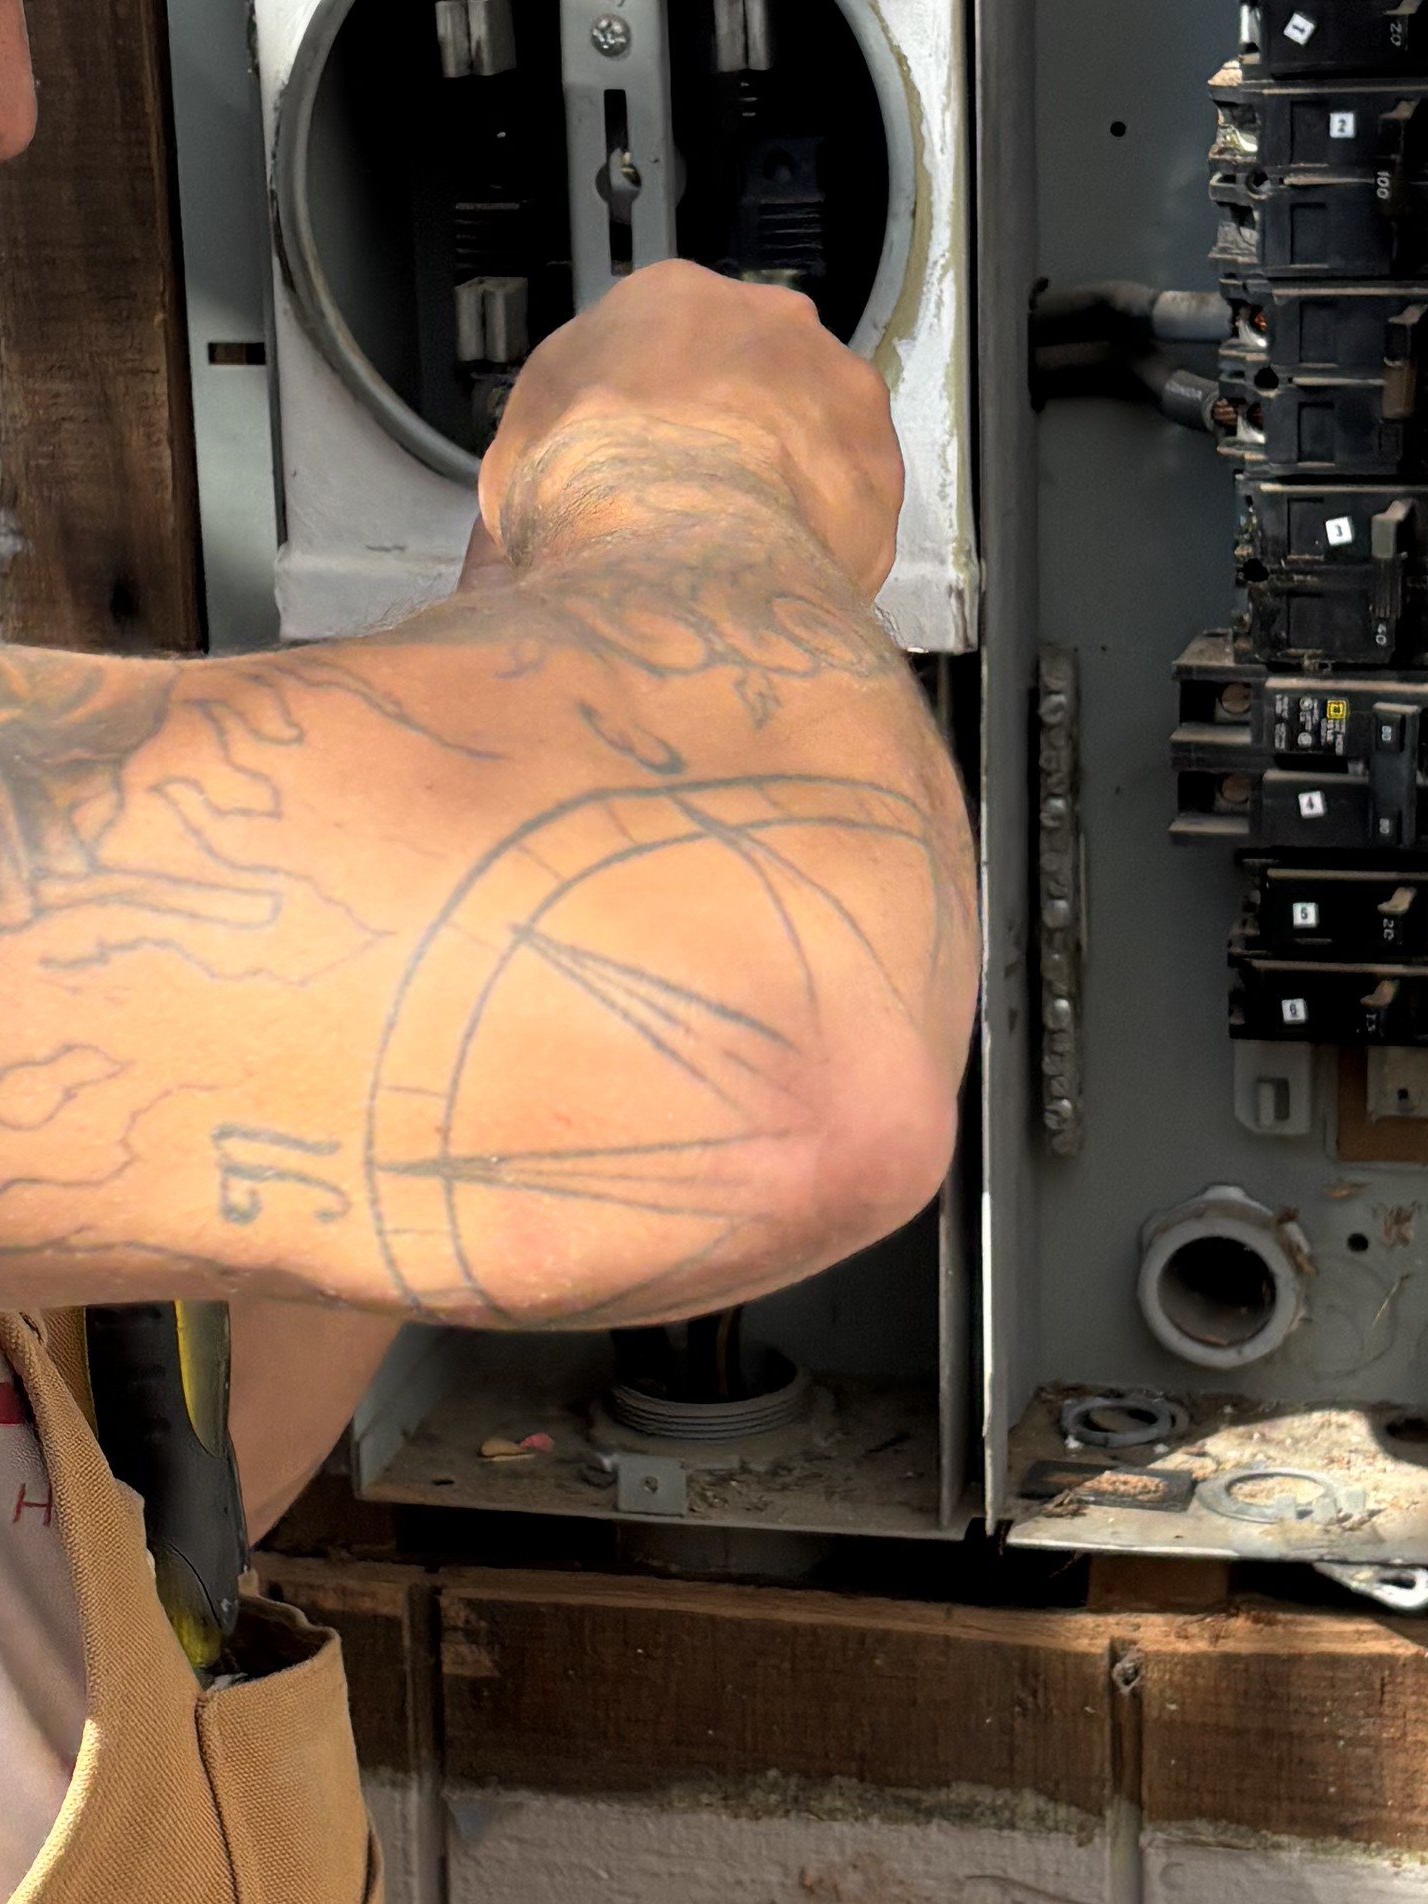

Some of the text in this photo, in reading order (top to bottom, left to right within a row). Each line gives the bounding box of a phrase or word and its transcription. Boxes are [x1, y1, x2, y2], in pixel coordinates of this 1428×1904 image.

[1390, 23, 1403, 47] 20
[1377, 171, 1390, 200] 100
[1383, 918, 1395, 940] 20
